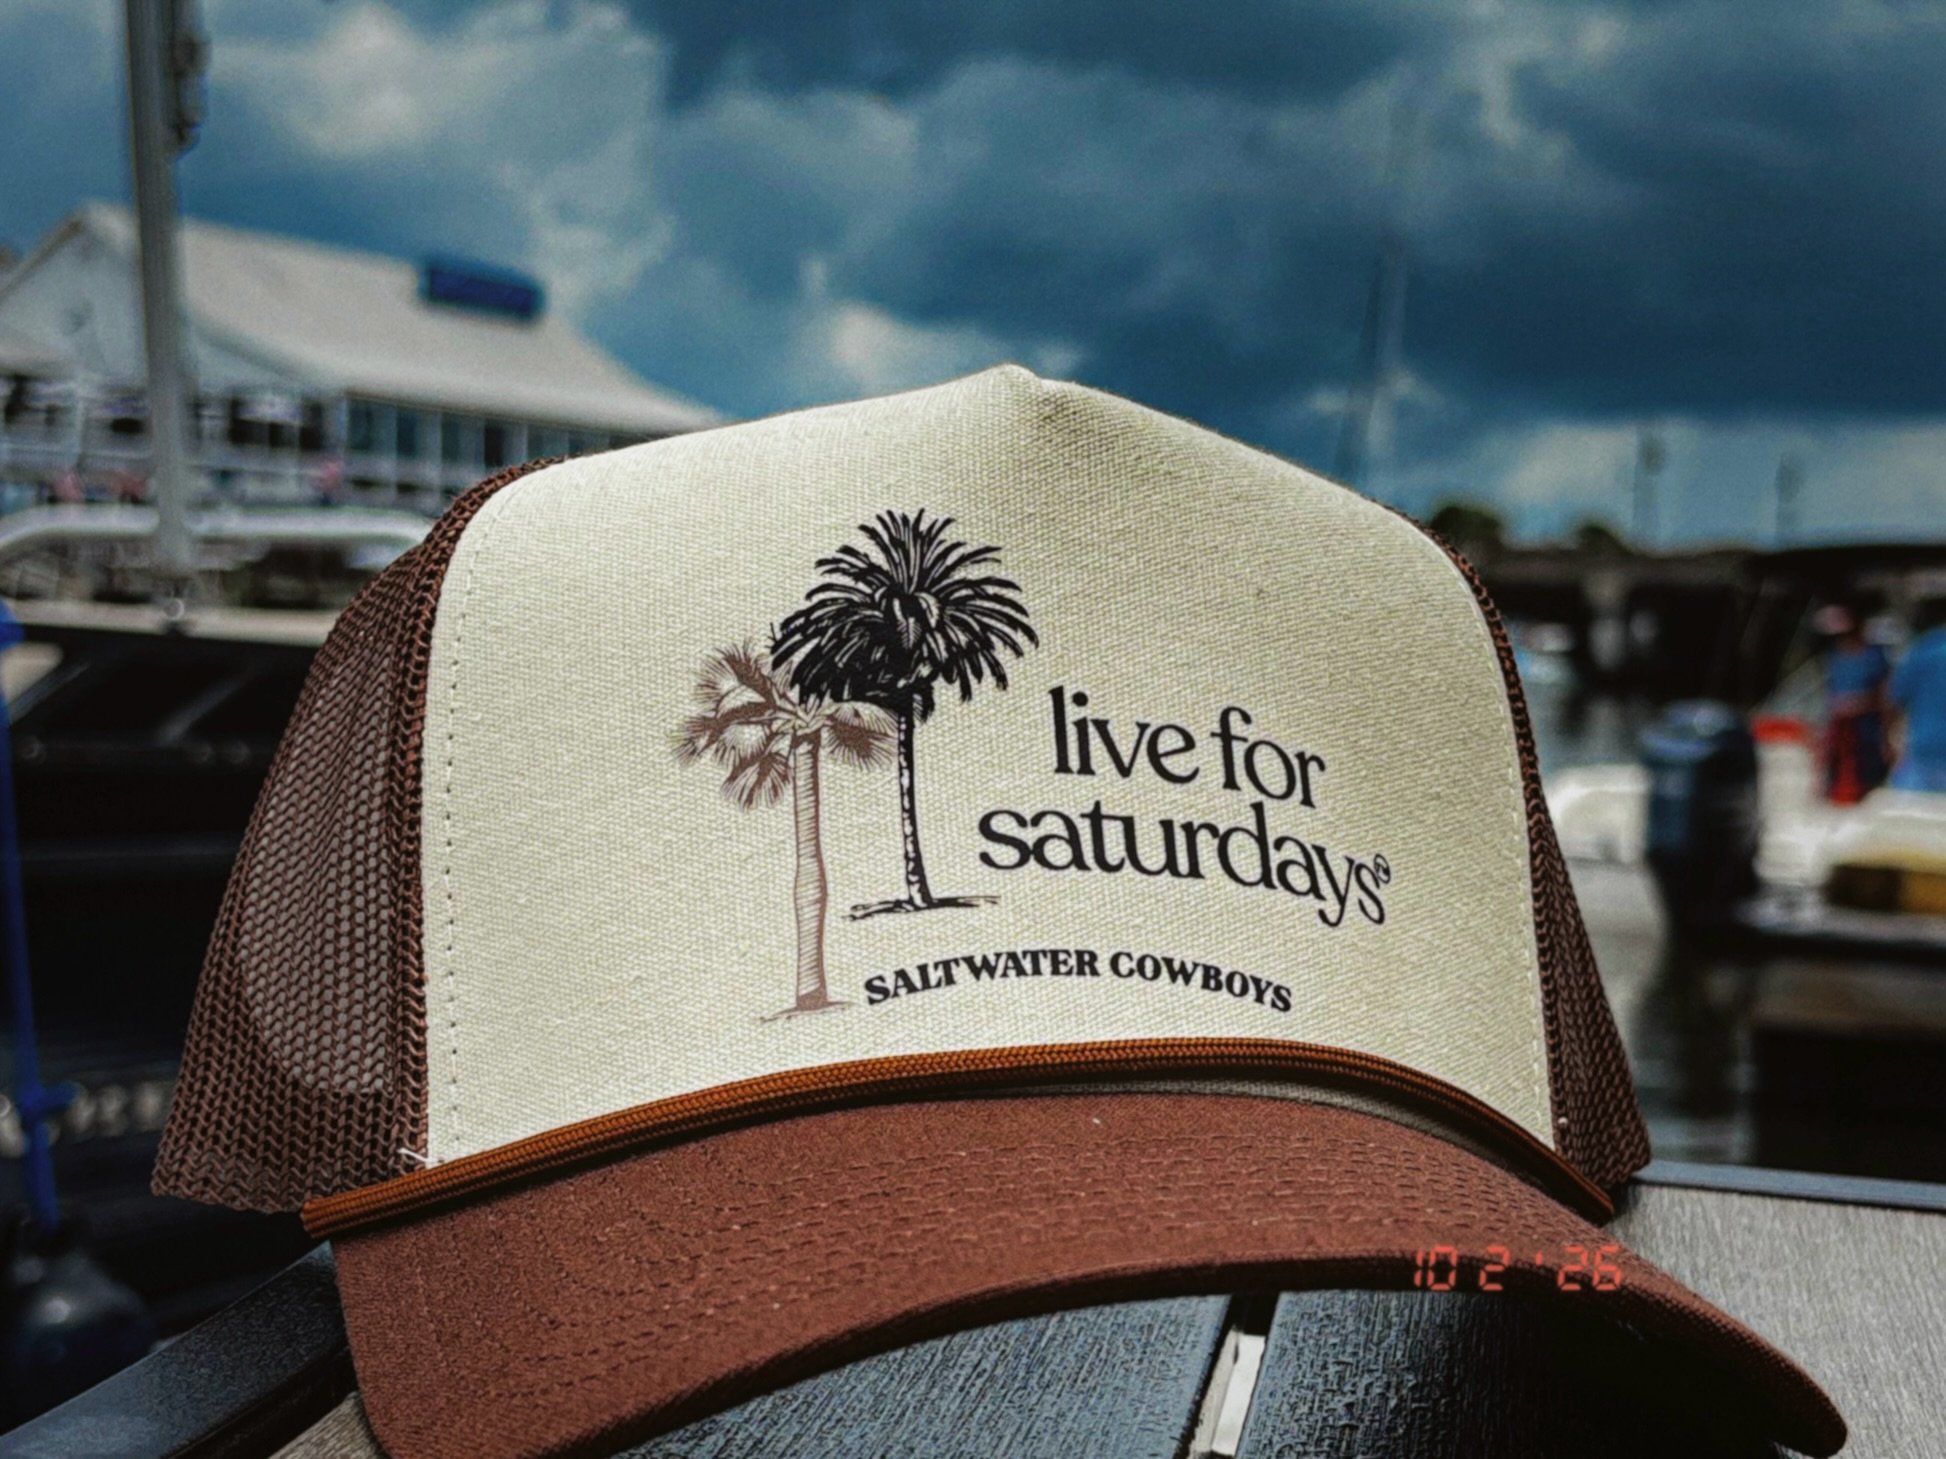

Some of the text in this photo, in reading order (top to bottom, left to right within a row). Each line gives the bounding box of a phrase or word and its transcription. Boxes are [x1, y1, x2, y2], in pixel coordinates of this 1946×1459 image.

[1048, 685, 1326, 809] live for
[864, 949, 1292, 1013] SALTWATER COWBOYS
